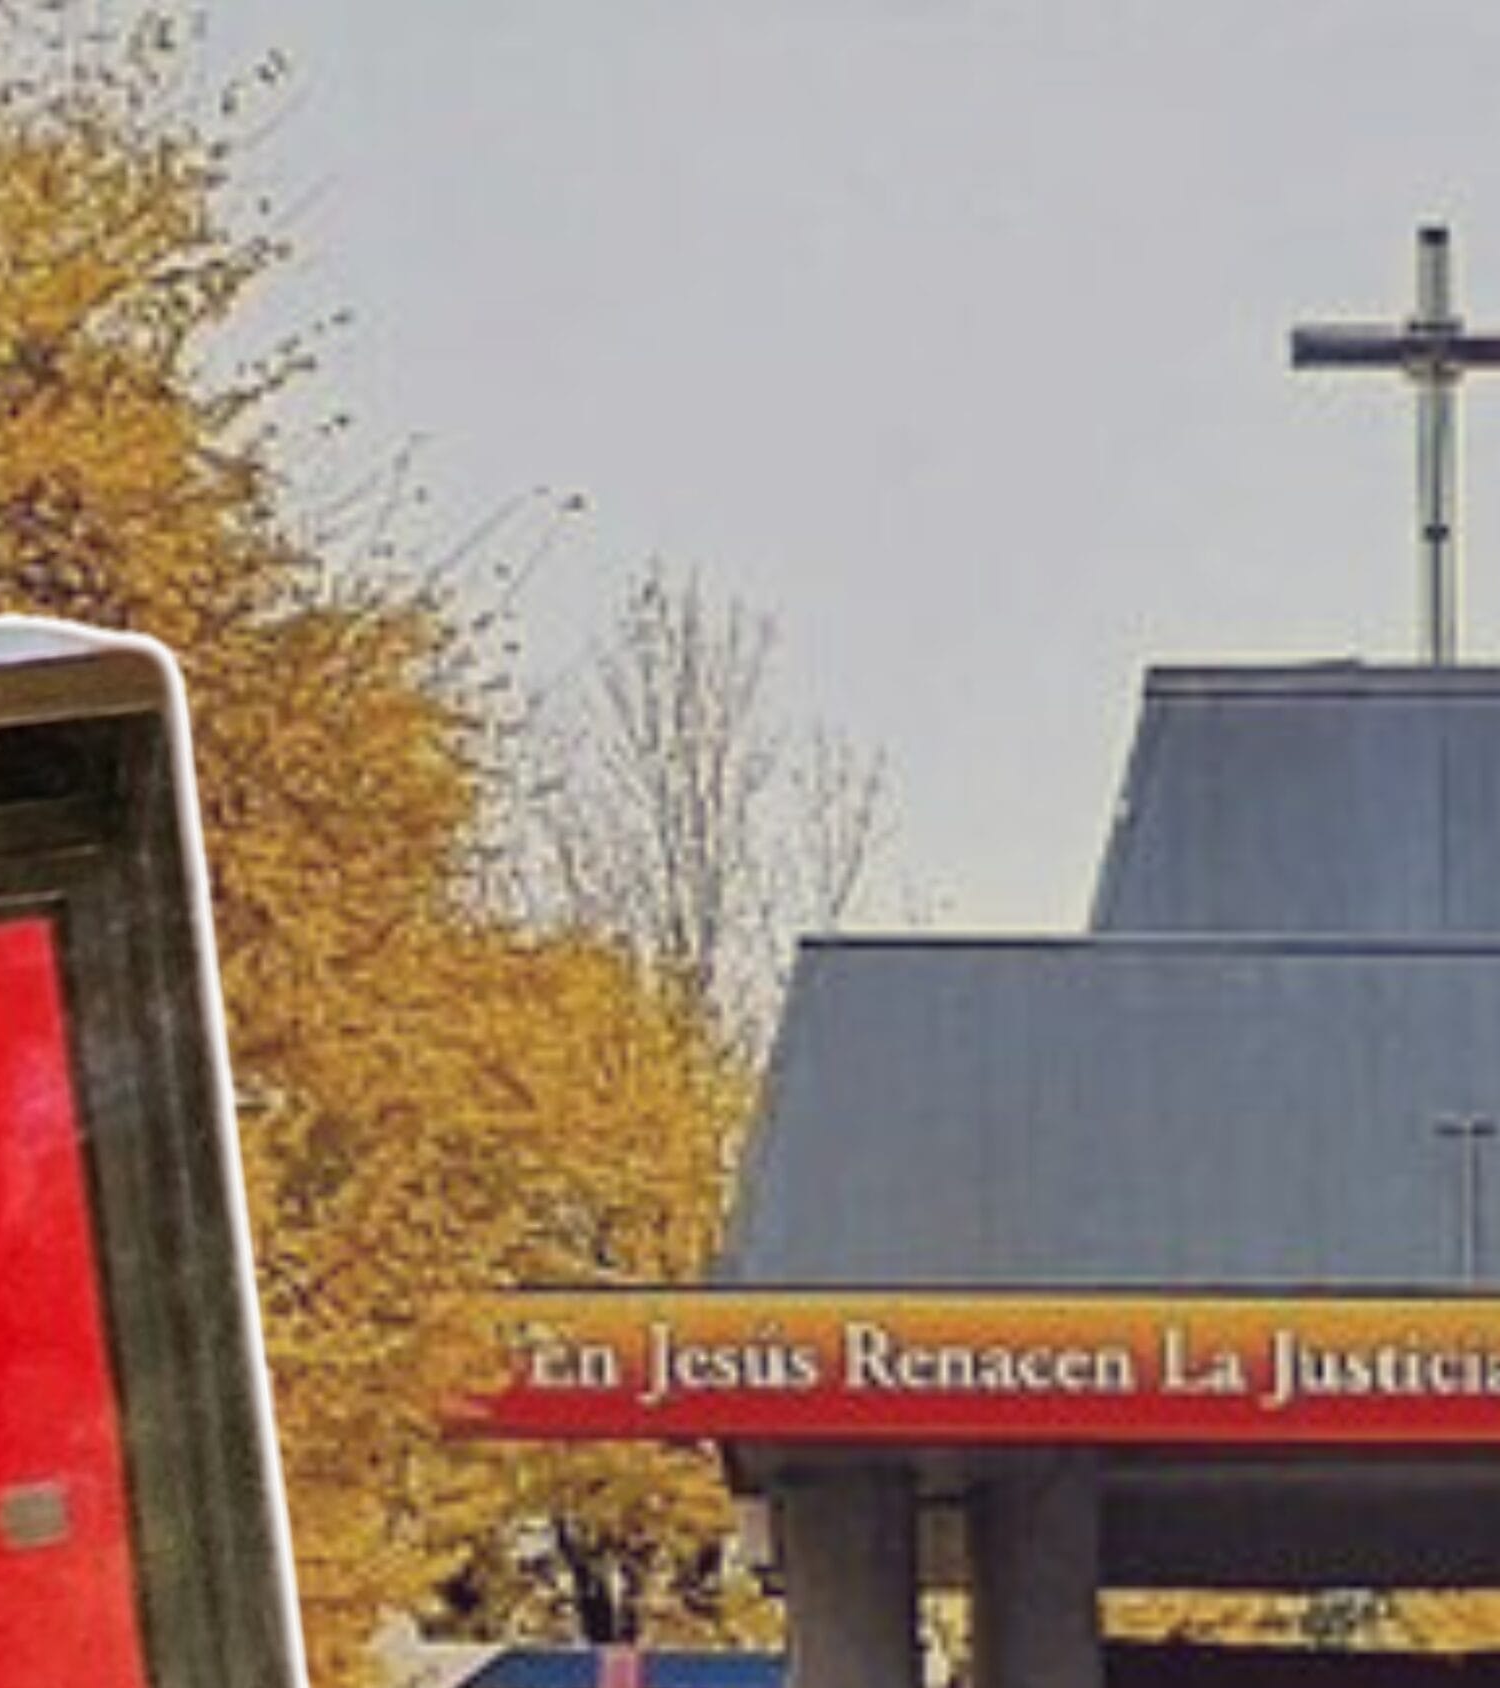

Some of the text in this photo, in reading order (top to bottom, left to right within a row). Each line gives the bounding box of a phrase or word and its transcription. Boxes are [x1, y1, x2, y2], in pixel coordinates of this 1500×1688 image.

[638, 1320, 819, 1405] Jesús
[845, 1320, 1134, 1389] Renacen
[1162, 1325, 1247, 1393] La
